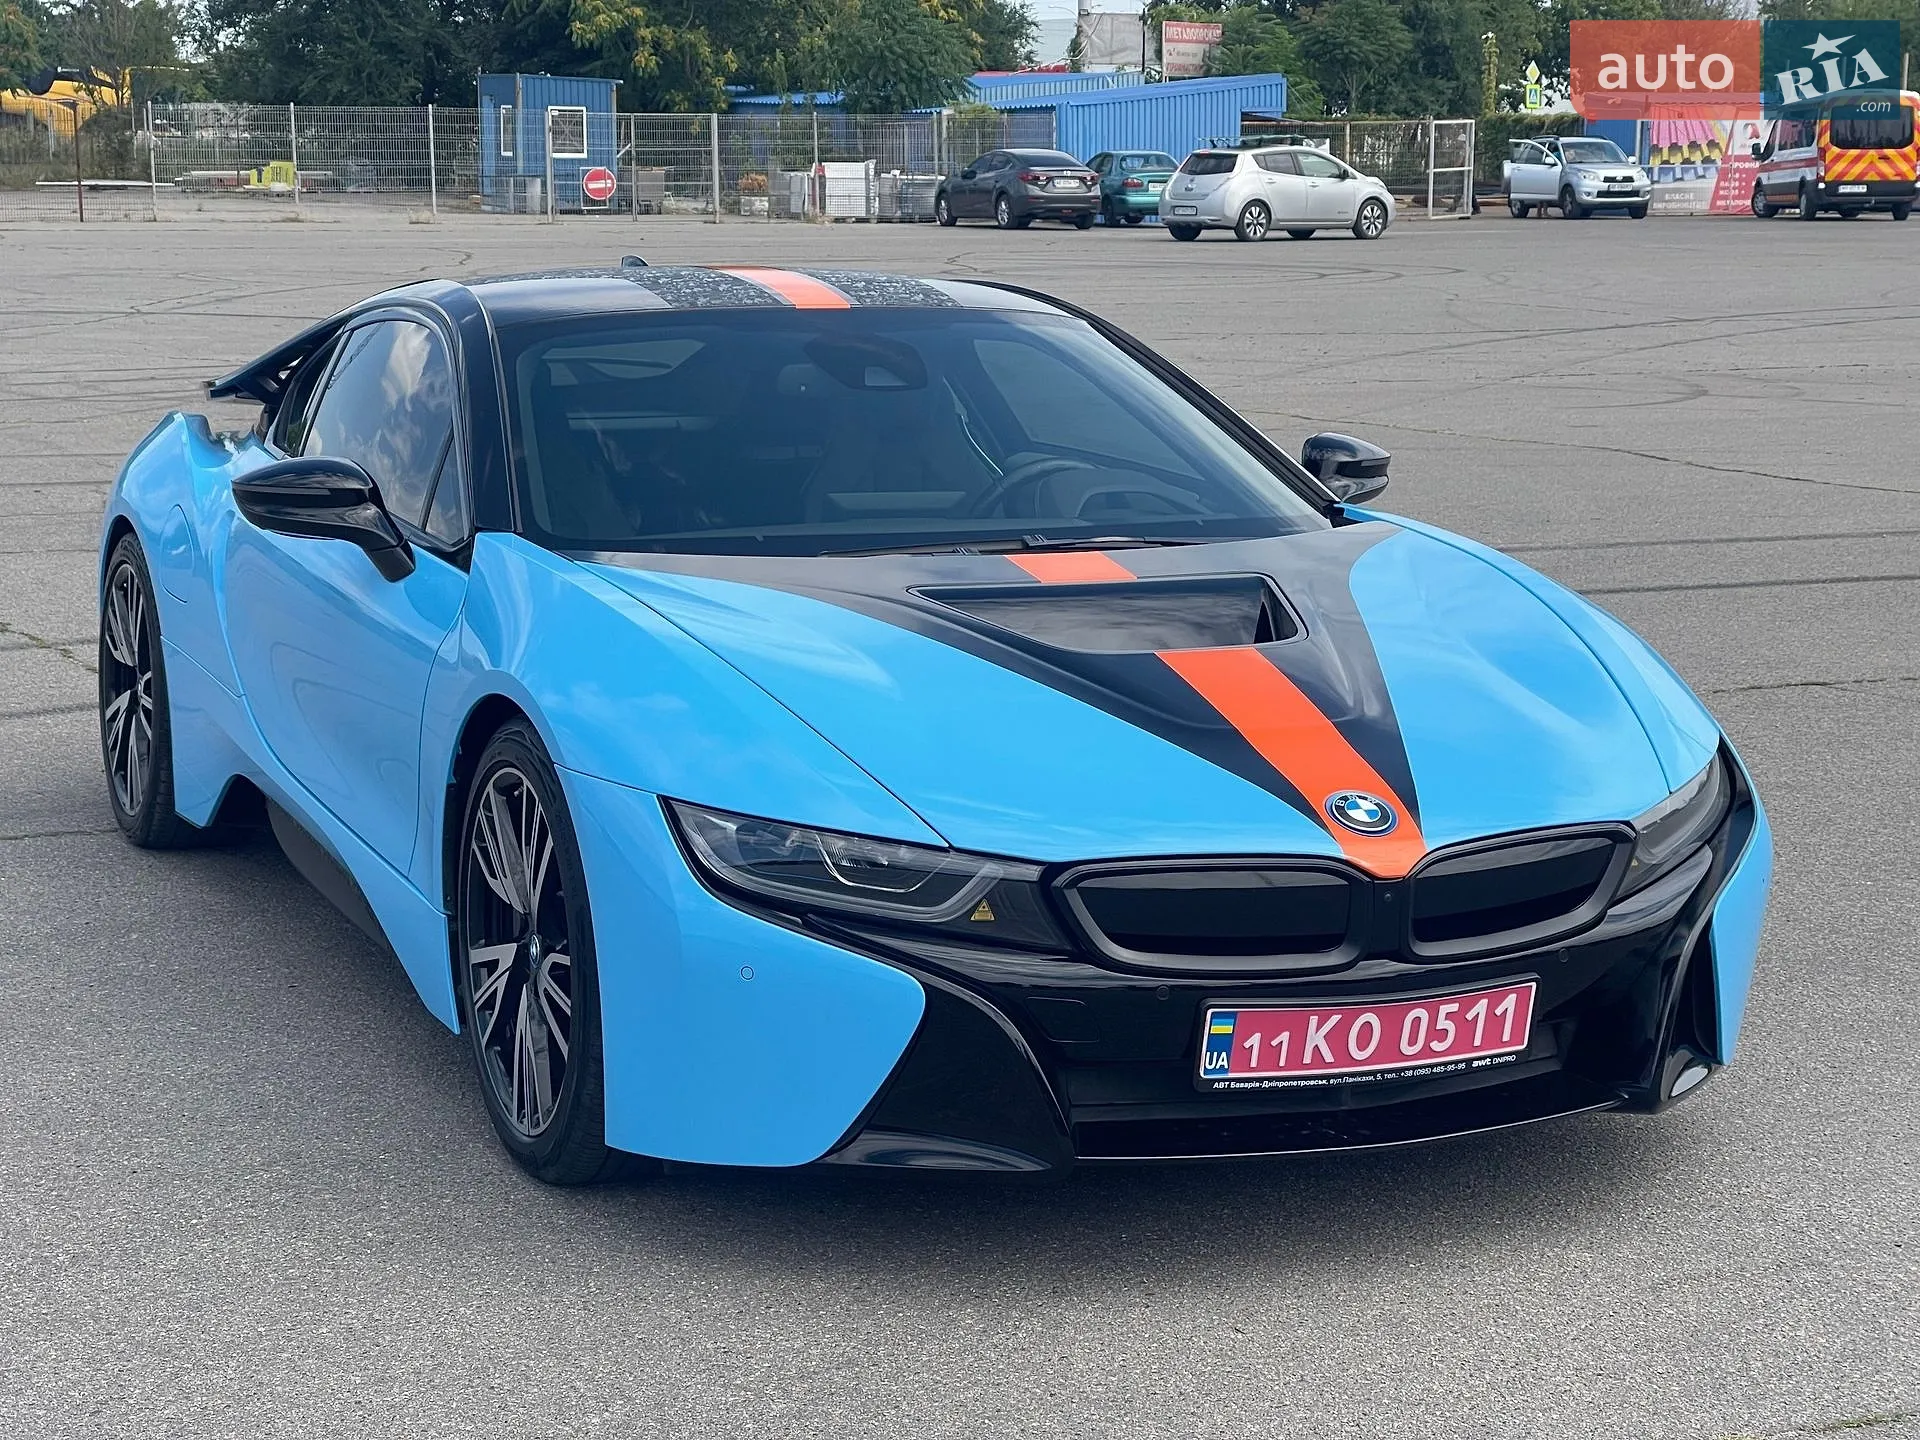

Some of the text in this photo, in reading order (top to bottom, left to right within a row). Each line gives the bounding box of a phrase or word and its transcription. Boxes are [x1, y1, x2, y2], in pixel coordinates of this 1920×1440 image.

[1399, 993, 1517, 1056] 0511
[1205, 1051, 1229, 1069] UA
[1492, 1054, 1517, 1065] DNIPRO
[1400, 1069, 1413, 1077] +38
[1413, 1067, 1432, 1077] (095)
[1432, 1062, 1467, 1073] 485-95-95
